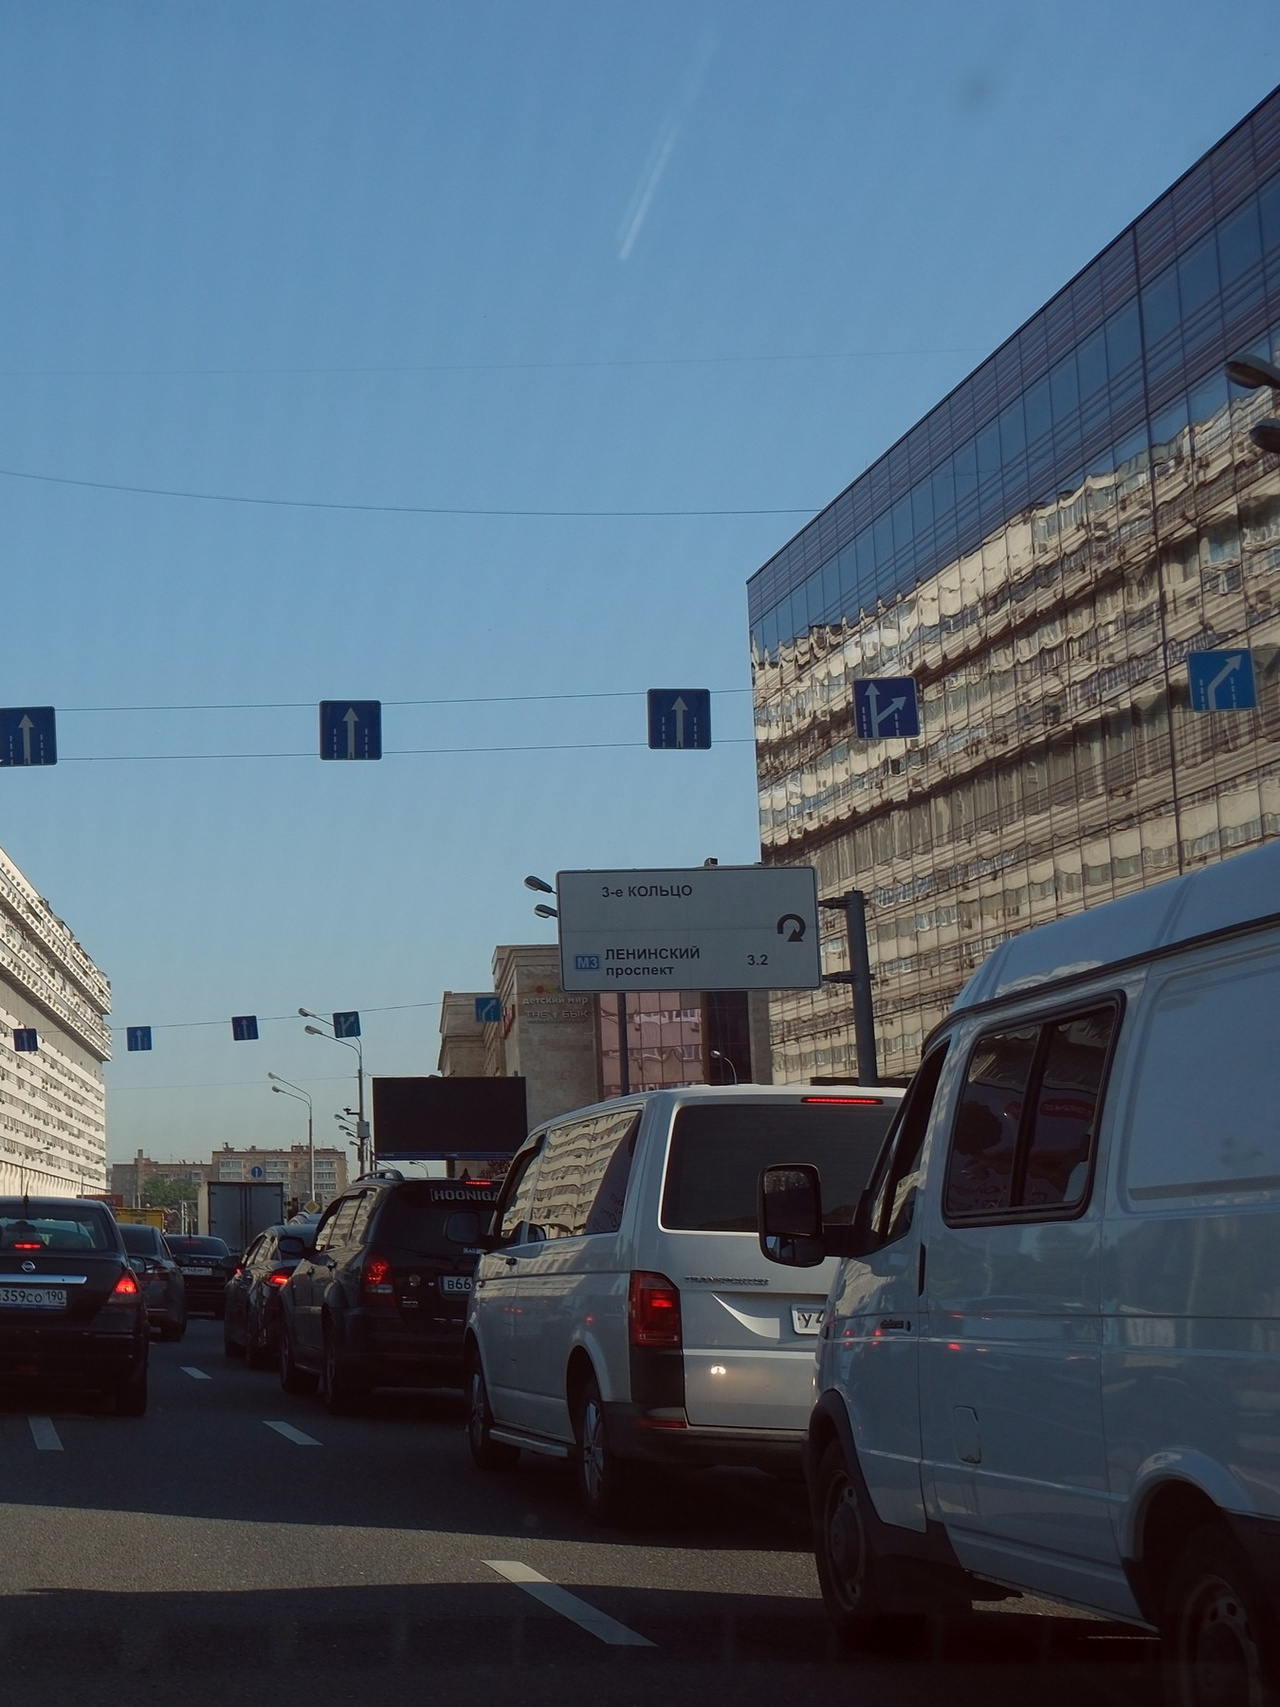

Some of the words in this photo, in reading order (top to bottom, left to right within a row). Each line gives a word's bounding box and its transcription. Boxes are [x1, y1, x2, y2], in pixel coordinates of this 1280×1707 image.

[601, 886, 623, 898] 3-е
[628, 884, 693, 899] КОЛЬЦО
[604, 945, 700, 960] ЛЕНИНСКИЙ
[577, 957, 599, 969] М3
[747, 954, 769, 966] 3.2
[606, 966, 675, 978] проспект
